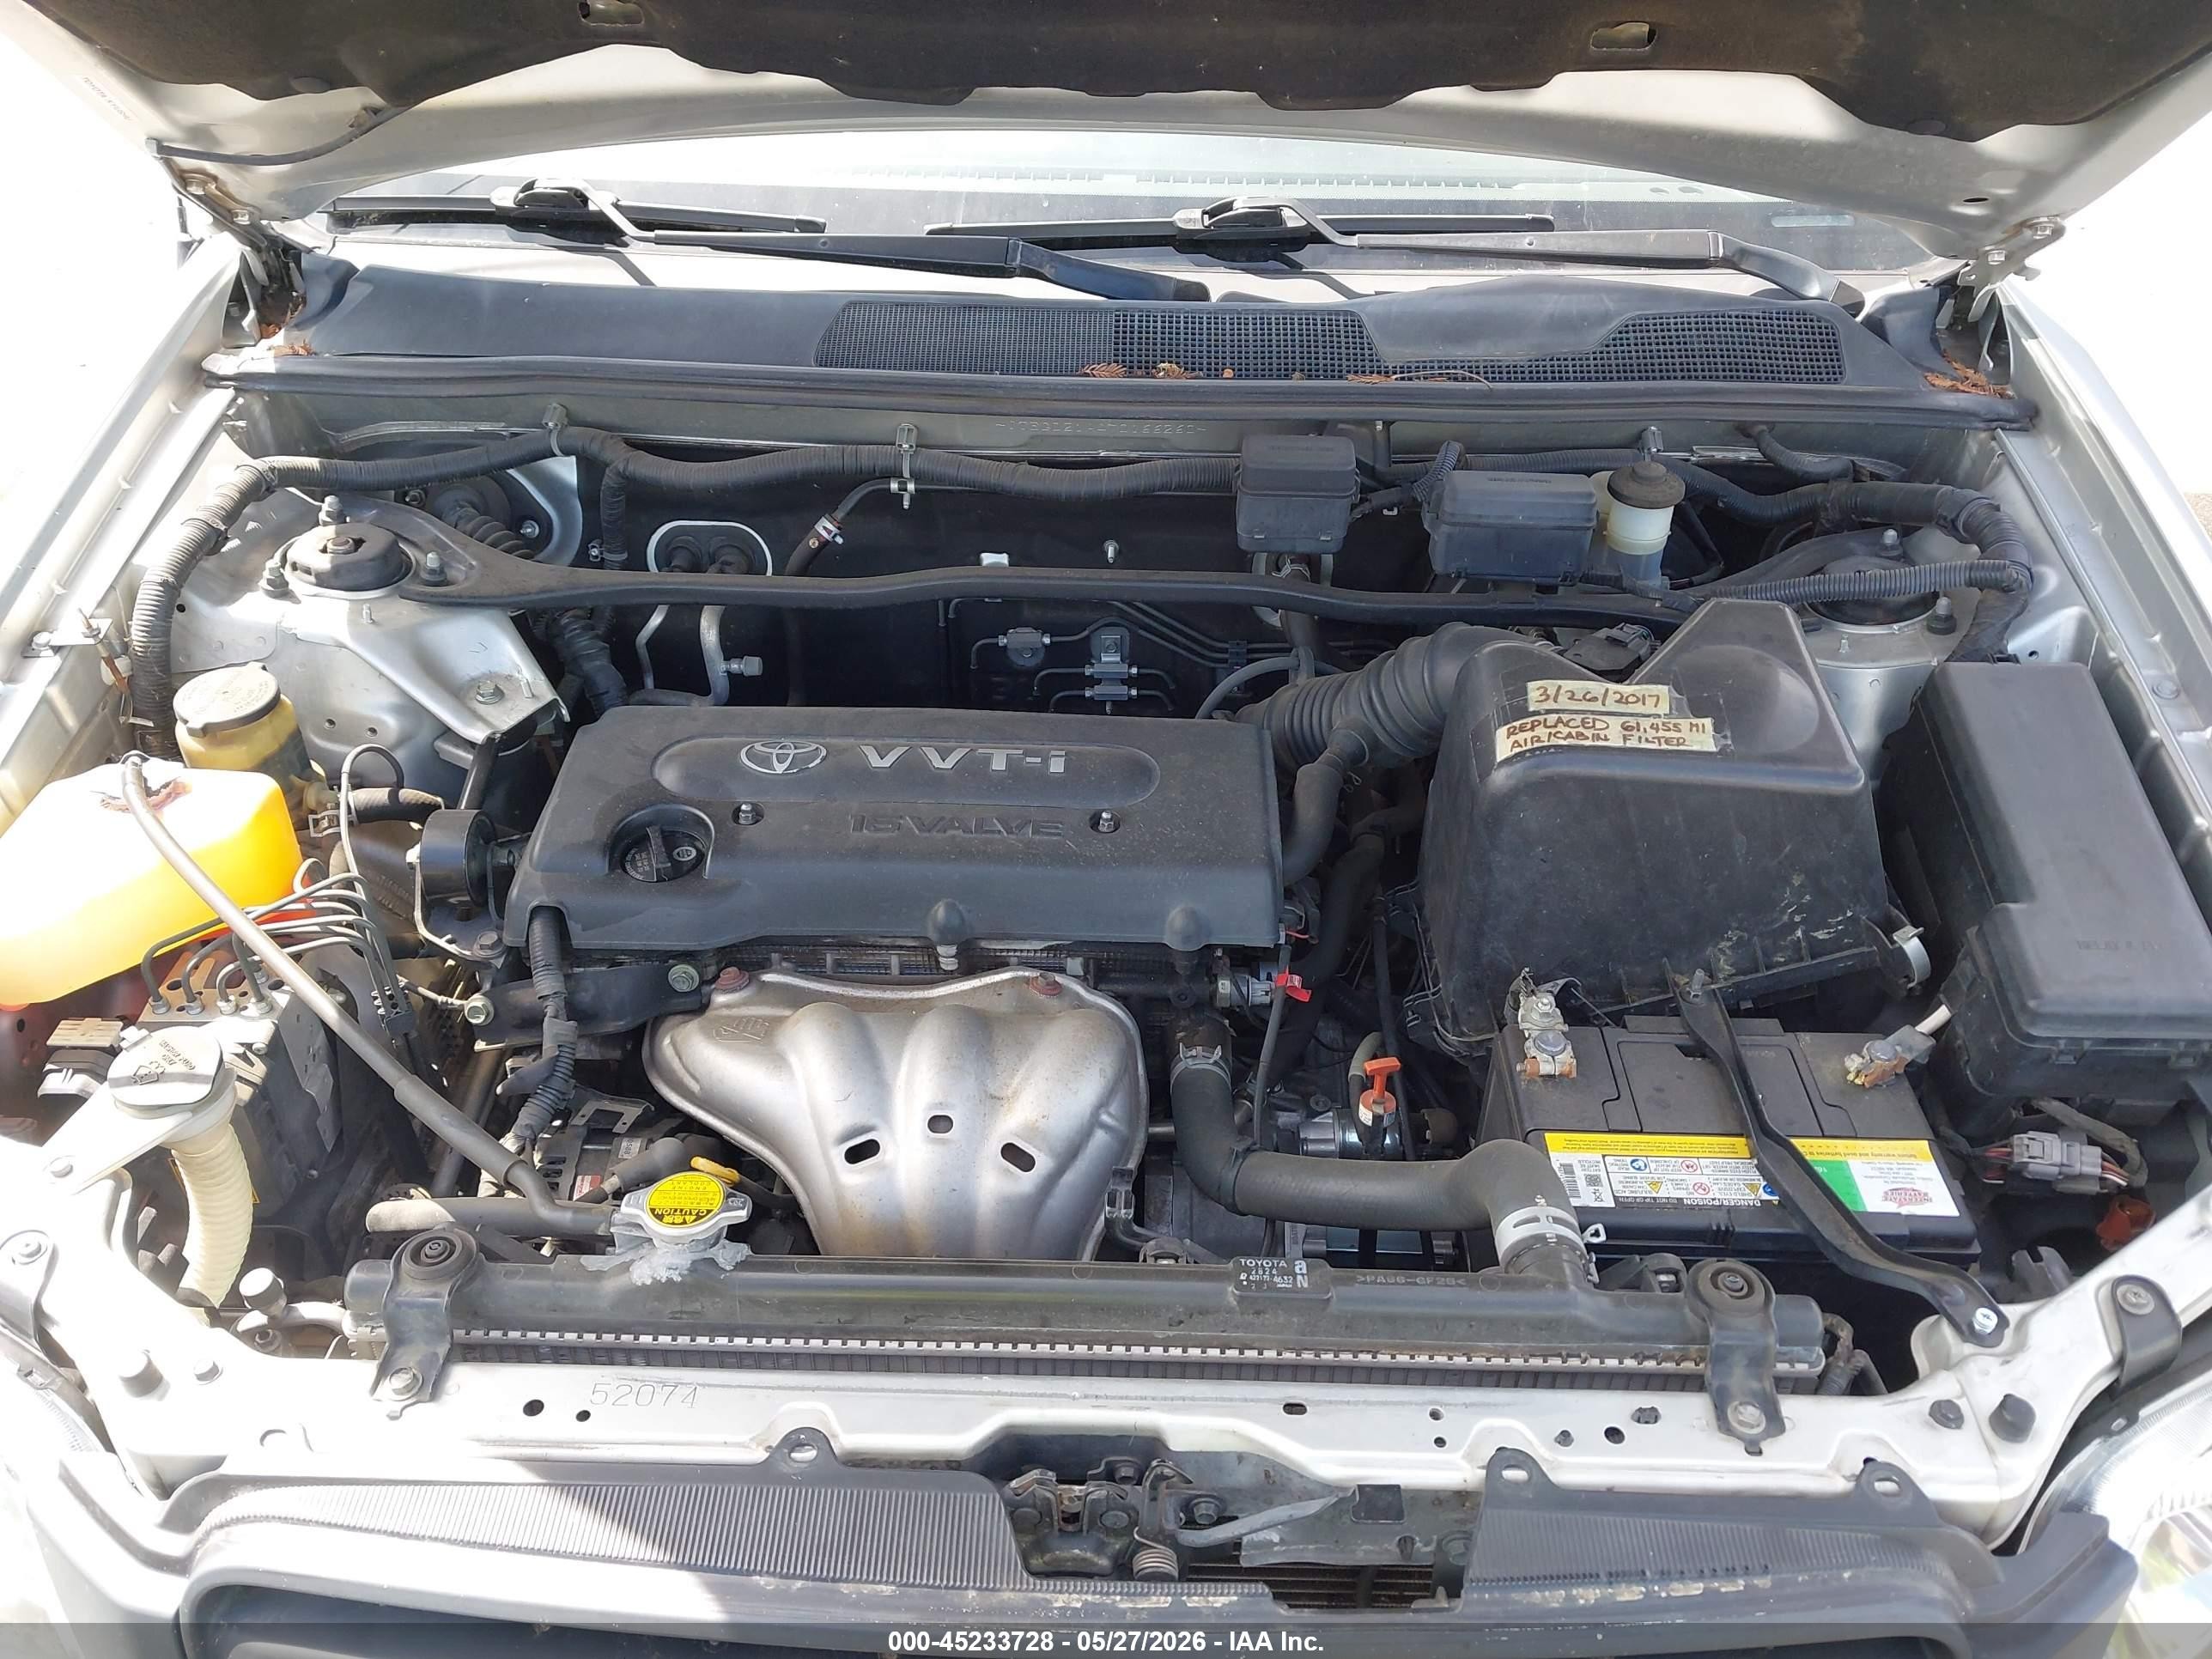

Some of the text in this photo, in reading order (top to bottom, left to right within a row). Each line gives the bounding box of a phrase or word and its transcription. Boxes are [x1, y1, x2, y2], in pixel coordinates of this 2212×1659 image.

[1534, 685, 1660, 708] 3/26/2017
[1506, 718, 1609, 739] REPLACED
[1690, 722, 1706, 734] MI
[1510, 731, 1691, 752] AIR/CABIN FILTER
[859, 744, 1066, 773] VVT-i
[1683, 1198, 1761, 1206] DANGER/POISON
[1239, 1259, 1287, 1267] TOYOTA
[590, 1382, 698, 1408] 52074
